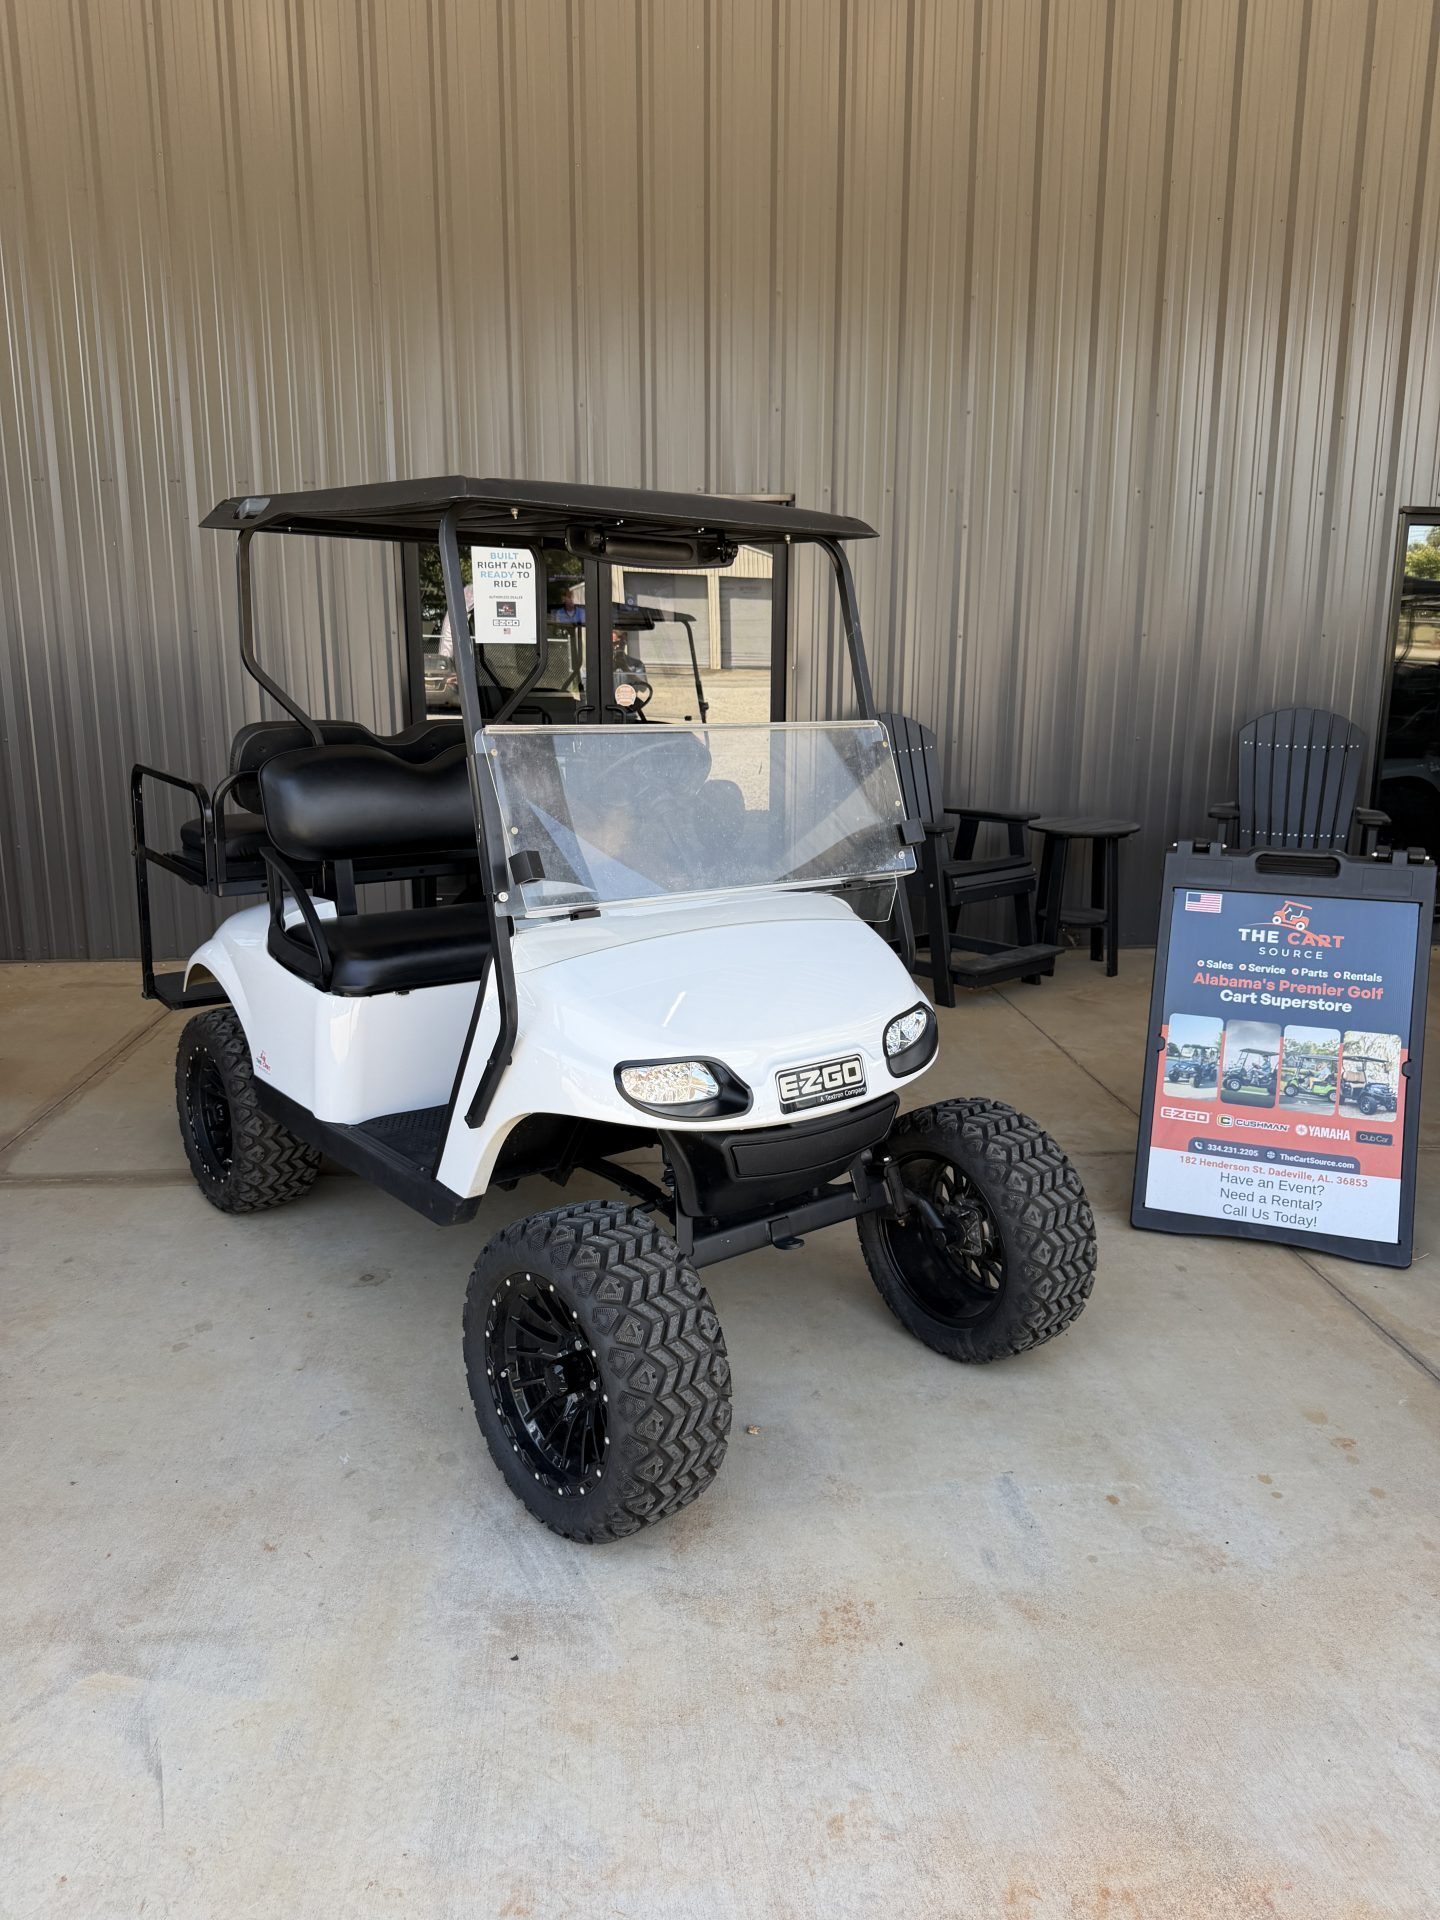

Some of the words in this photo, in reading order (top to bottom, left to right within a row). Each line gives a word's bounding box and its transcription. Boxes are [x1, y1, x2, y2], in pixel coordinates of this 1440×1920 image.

[490, 552, 519, 560] BUILT
[493, 580, 518, 588] RIDE
[517, 571, 530, 579] TO
[1238, 928, 1279, 944] THE
[1287, 932, 1345, 949] CART
[1258, 946, 1324, 960] SOURCE
[1206, 959, 1234, 970] Sales
[1248, 963, 1286, 975] Service
[1301, 968, 1328, 979] Parts
[1343, 971, 1383, 983] Rentals
[1193, 972, 1275, 991] Alabama's
[1278, 981, 1344, 997] Premier
[1347, 985, 1384, 1001] Golf
[1220, 989, 1257, 1004] Cart
[1260, 993, 1353, 1013] Superstore
[825, 1093, 844, 1101] Textron
[844, 1087, 866, 1097] Company
[1236, 1119, 1288, 1131] CUSHMAN
[1308, 1125, 1350, 1141] YAMAHA
[1207, 1143, 1259, 1157] 334.231.2205
[1280, 1153, 1354, 1169] TheCartSource.com
[1179, 1155, 1197, 1165] 182
[1199, 1157, 1251, 1172] Henderson
[1252, 1165, 1266, 1175] St.
[1268, 1167, 1315, 1182] Dadeville,
[1317, 1173, 1334, 1184] AL.
[1336, 1176, 1368, 1188] 36853
[1220, 1172, 1254, 1187] Have
[1257, 1179, 1274, 1189] an
[1279, 1180, 1325, 1196] Event?
[1220, 1187, 1255, 1203] Need
[1259, 1195, 1267, 1204] a
[1271, 1196, 1323, 1212] Rental?
[1222, 1203, 1248, 1218] Call
[1251, 1208, 1269, 1220] Us
[1273, 1211, 1318, 1228] Today!
